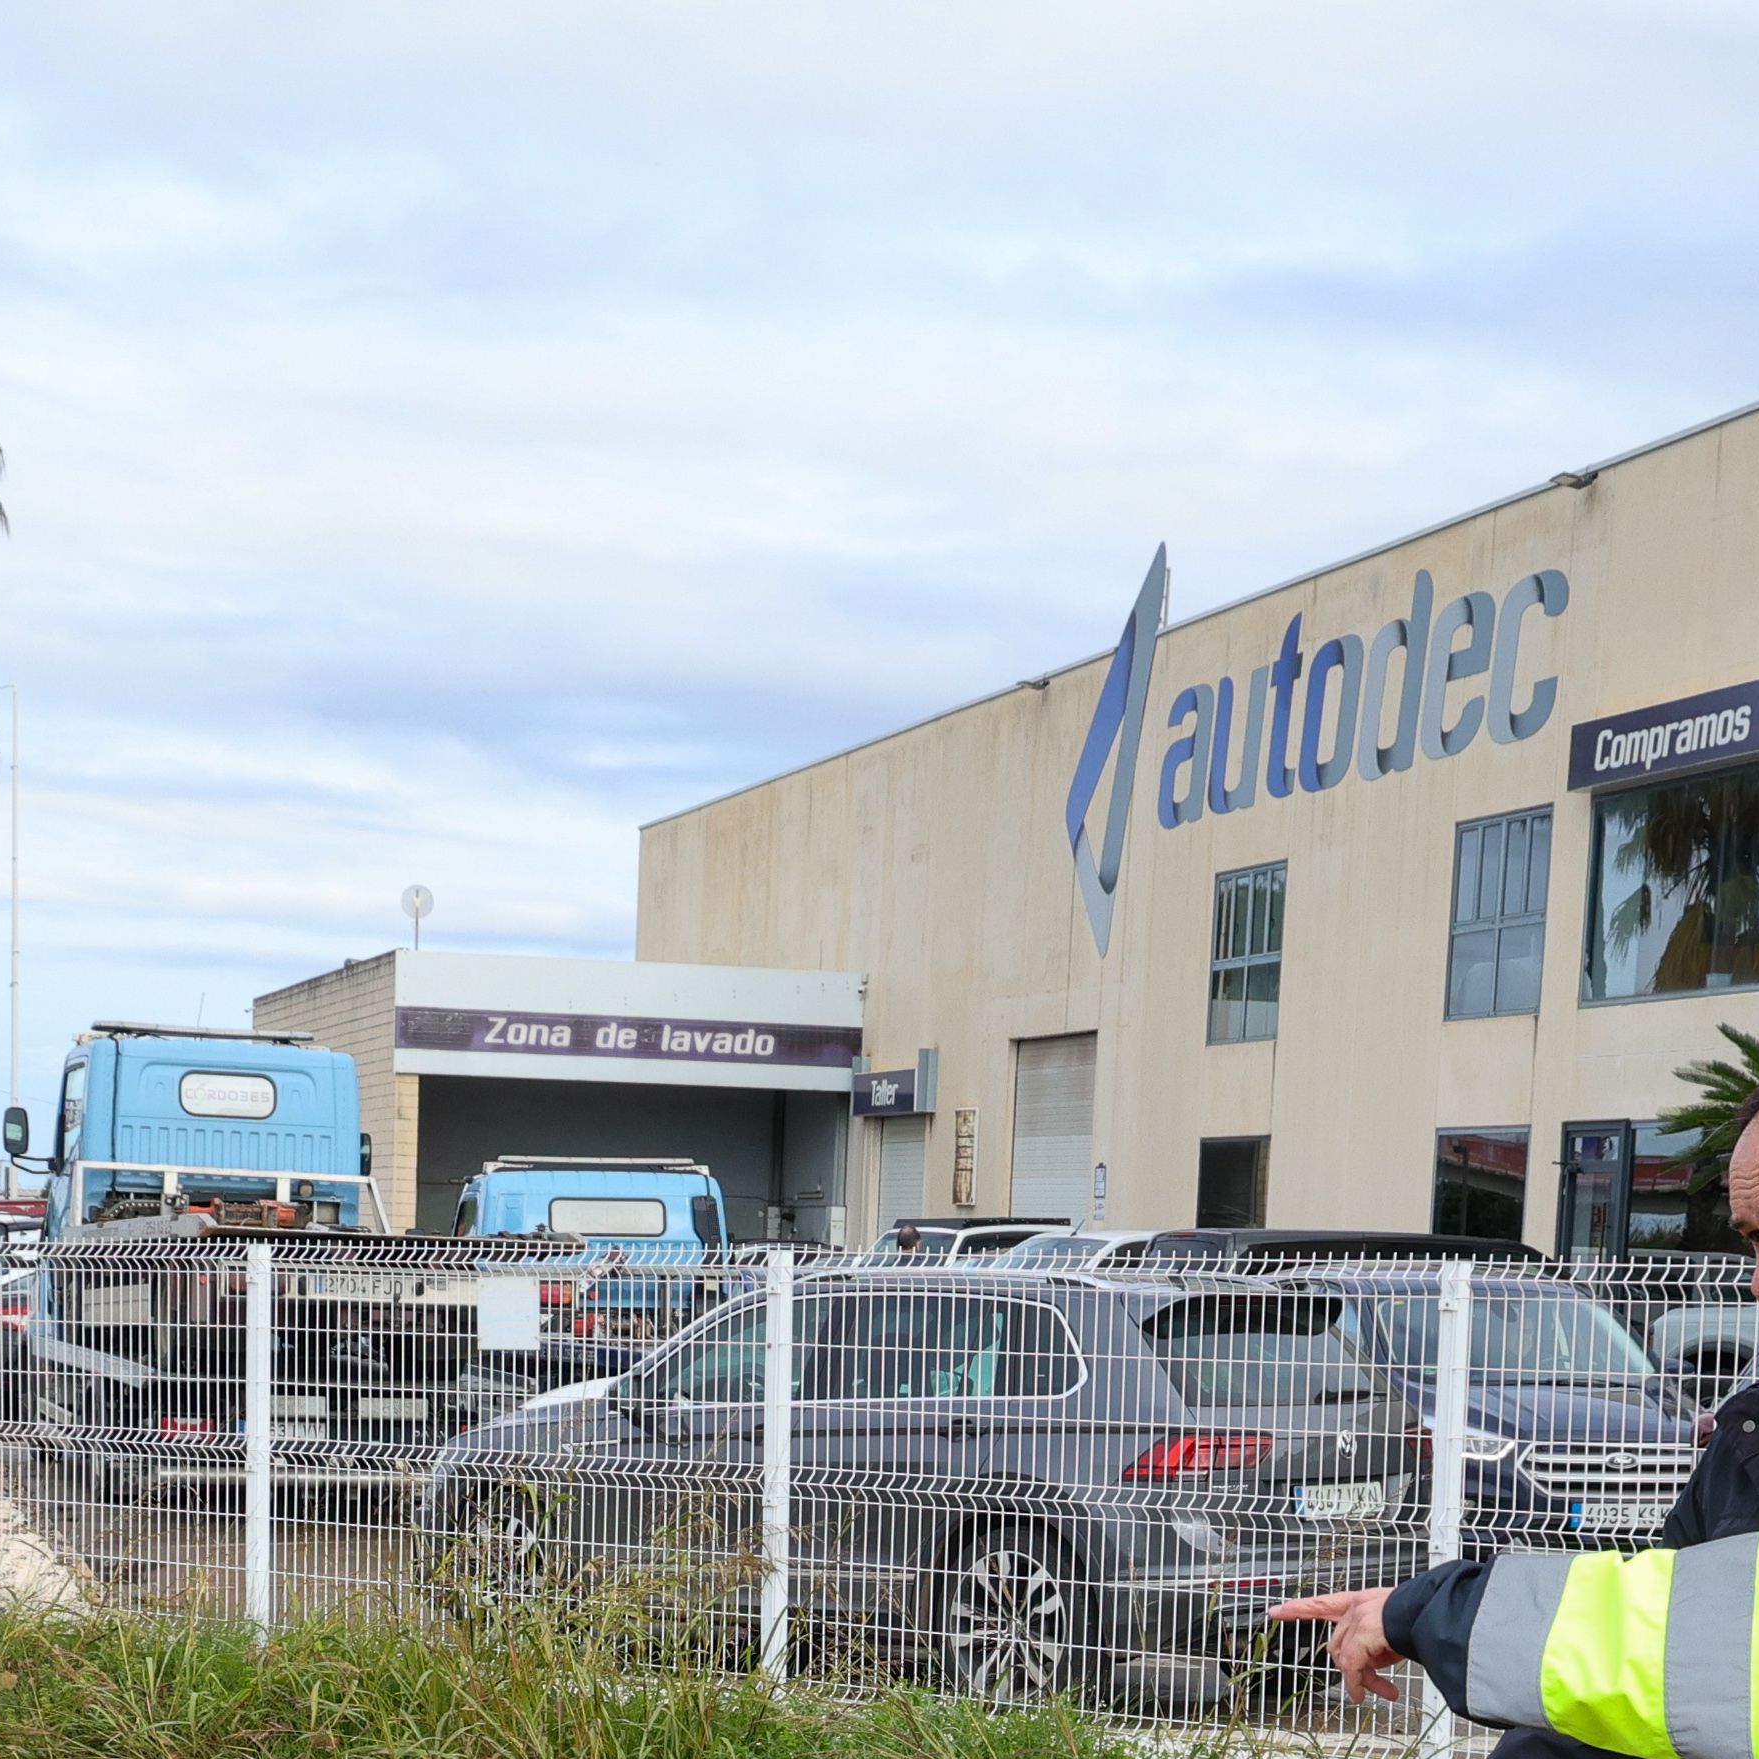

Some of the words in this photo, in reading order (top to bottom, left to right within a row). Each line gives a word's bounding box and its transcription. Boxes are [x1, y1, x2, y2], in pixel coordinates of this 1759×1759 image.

[1157, 569, 1570, 830] autodec
[1594, 701, 1752, 772] Compramos
[483, 1016, 571, 1048] Zona
[595, 1020, 637, 1049] de
[661, 1024, 775, 1056] lavado
[871, 1079, 899, 1106] Taller
